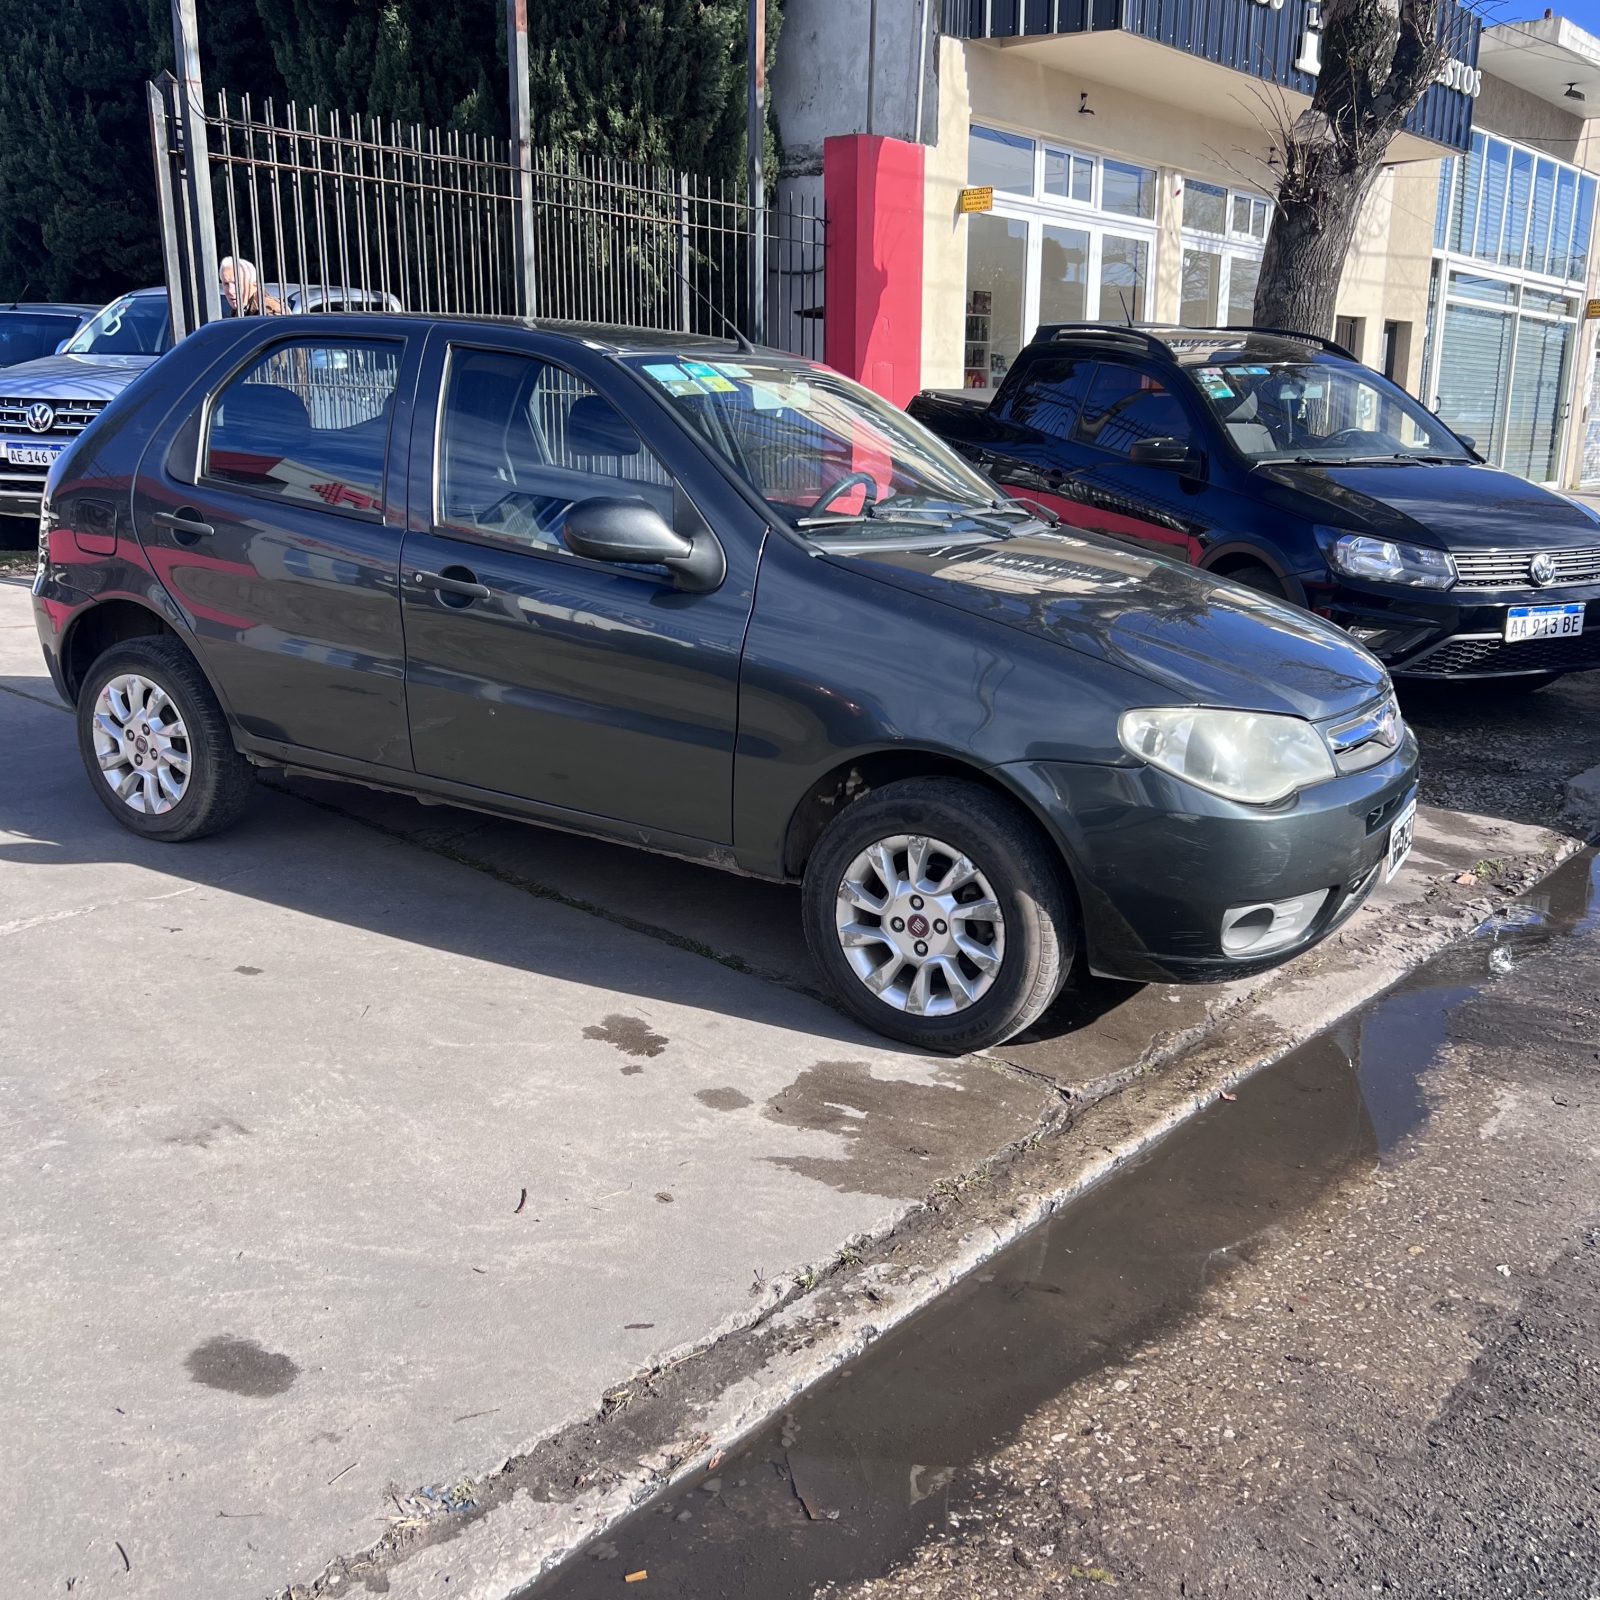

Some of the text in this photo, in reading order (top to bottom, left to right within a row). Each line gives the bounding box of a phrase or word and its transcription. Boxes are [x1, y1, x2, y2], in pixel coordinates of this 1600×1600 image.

[11, 450, 24, 463] AE
[27, 451, 48, 463] 146
[1511, 615, 1580, 637] AA 913 BE
